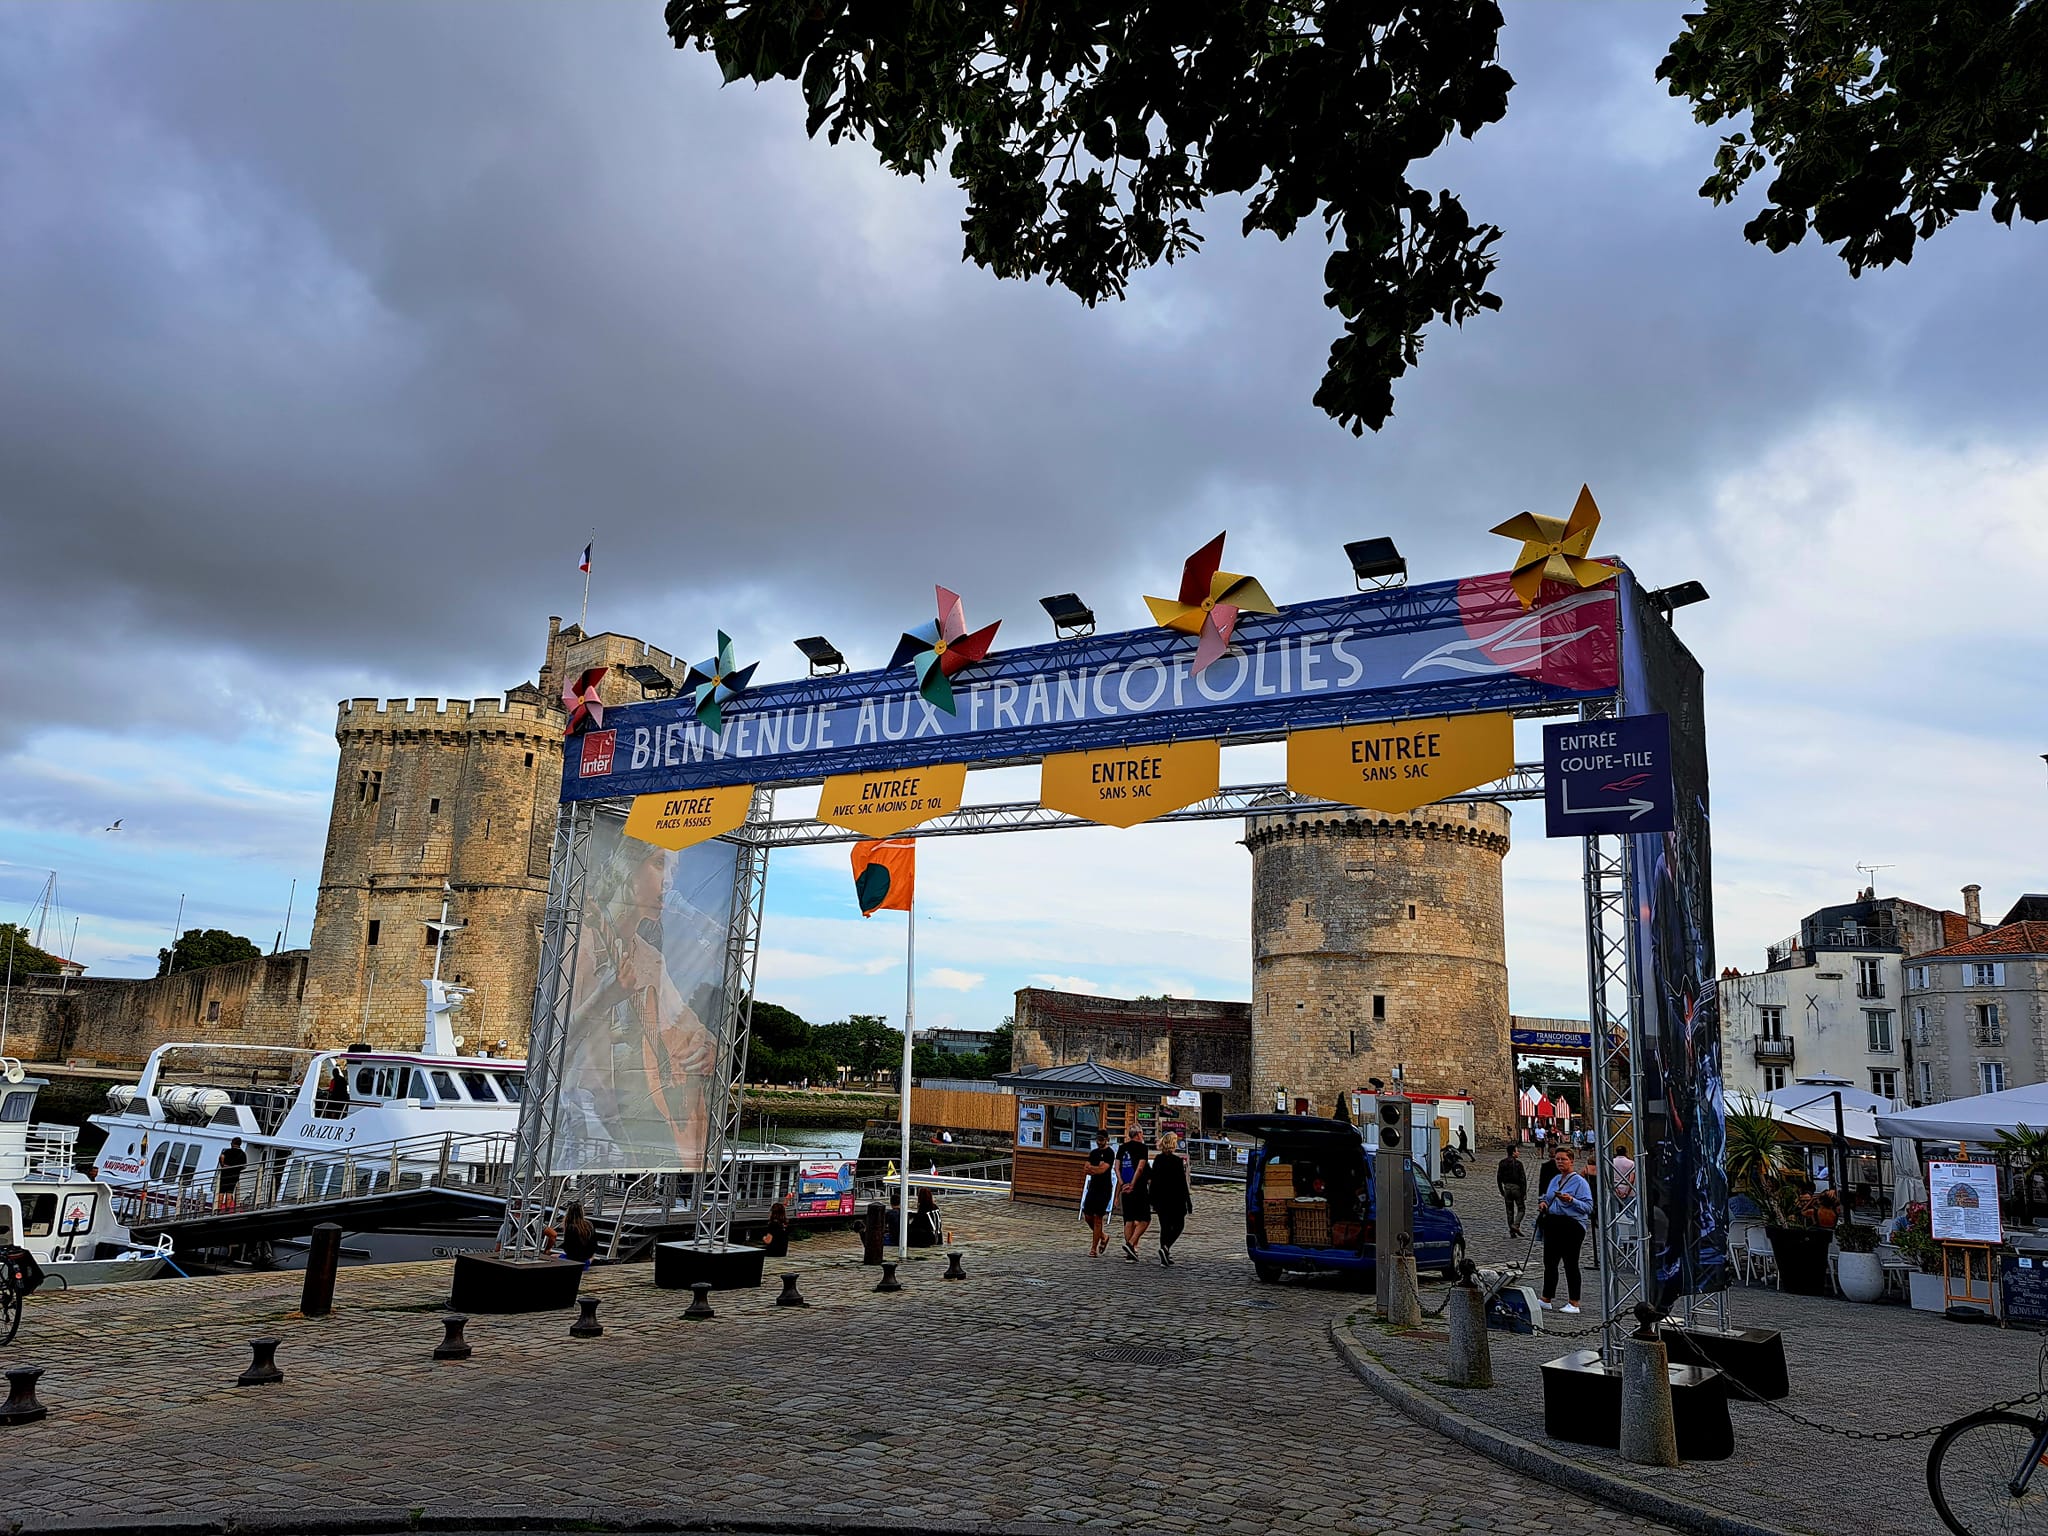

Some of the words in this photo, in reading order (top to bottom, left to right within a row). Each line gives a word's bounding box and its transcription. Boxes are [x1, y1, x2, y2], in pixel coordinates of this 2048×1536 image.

[631, 702, 838, 770] BIENVENUE
[855, 692, 945, 745] AUX
[970, 628, 1364, 732] FRANCOFOLIES
[1351, 731, 1441, 763] ENTRÉE
[1559, 730, 1617, 751] ENTRÉE
[582, 758, 611, 774] inter
[1092, 755, 1162, 783] ENTRÉE
[1362, 765, 1397, 782] SANS
[1403, 763, 1429, 779] SAC
[1560, 751, 1653, 773] COUPE-FILE
[861, 777, 921, 801] ENTRÉE
[1099, 785, 1127, 800] SANS
[1132, 784, 1152, 798] SAC
[663, 796, 715, 817] ENTRÉE
[832, 804, 855, 816] AVEC
[858, 803, 874, 814] SAC
[875, 800, 907, 813] MOINS
[910, 799, 924, 810] DE
[927, 797, 942, 809] 10L
[655, 818, 681, 830] PLACES
[683, 816, 712, 828] ASSISES
[300, 1123, 344, 1141] ORAZUR
[345, 1127, 356, 1142] 3
